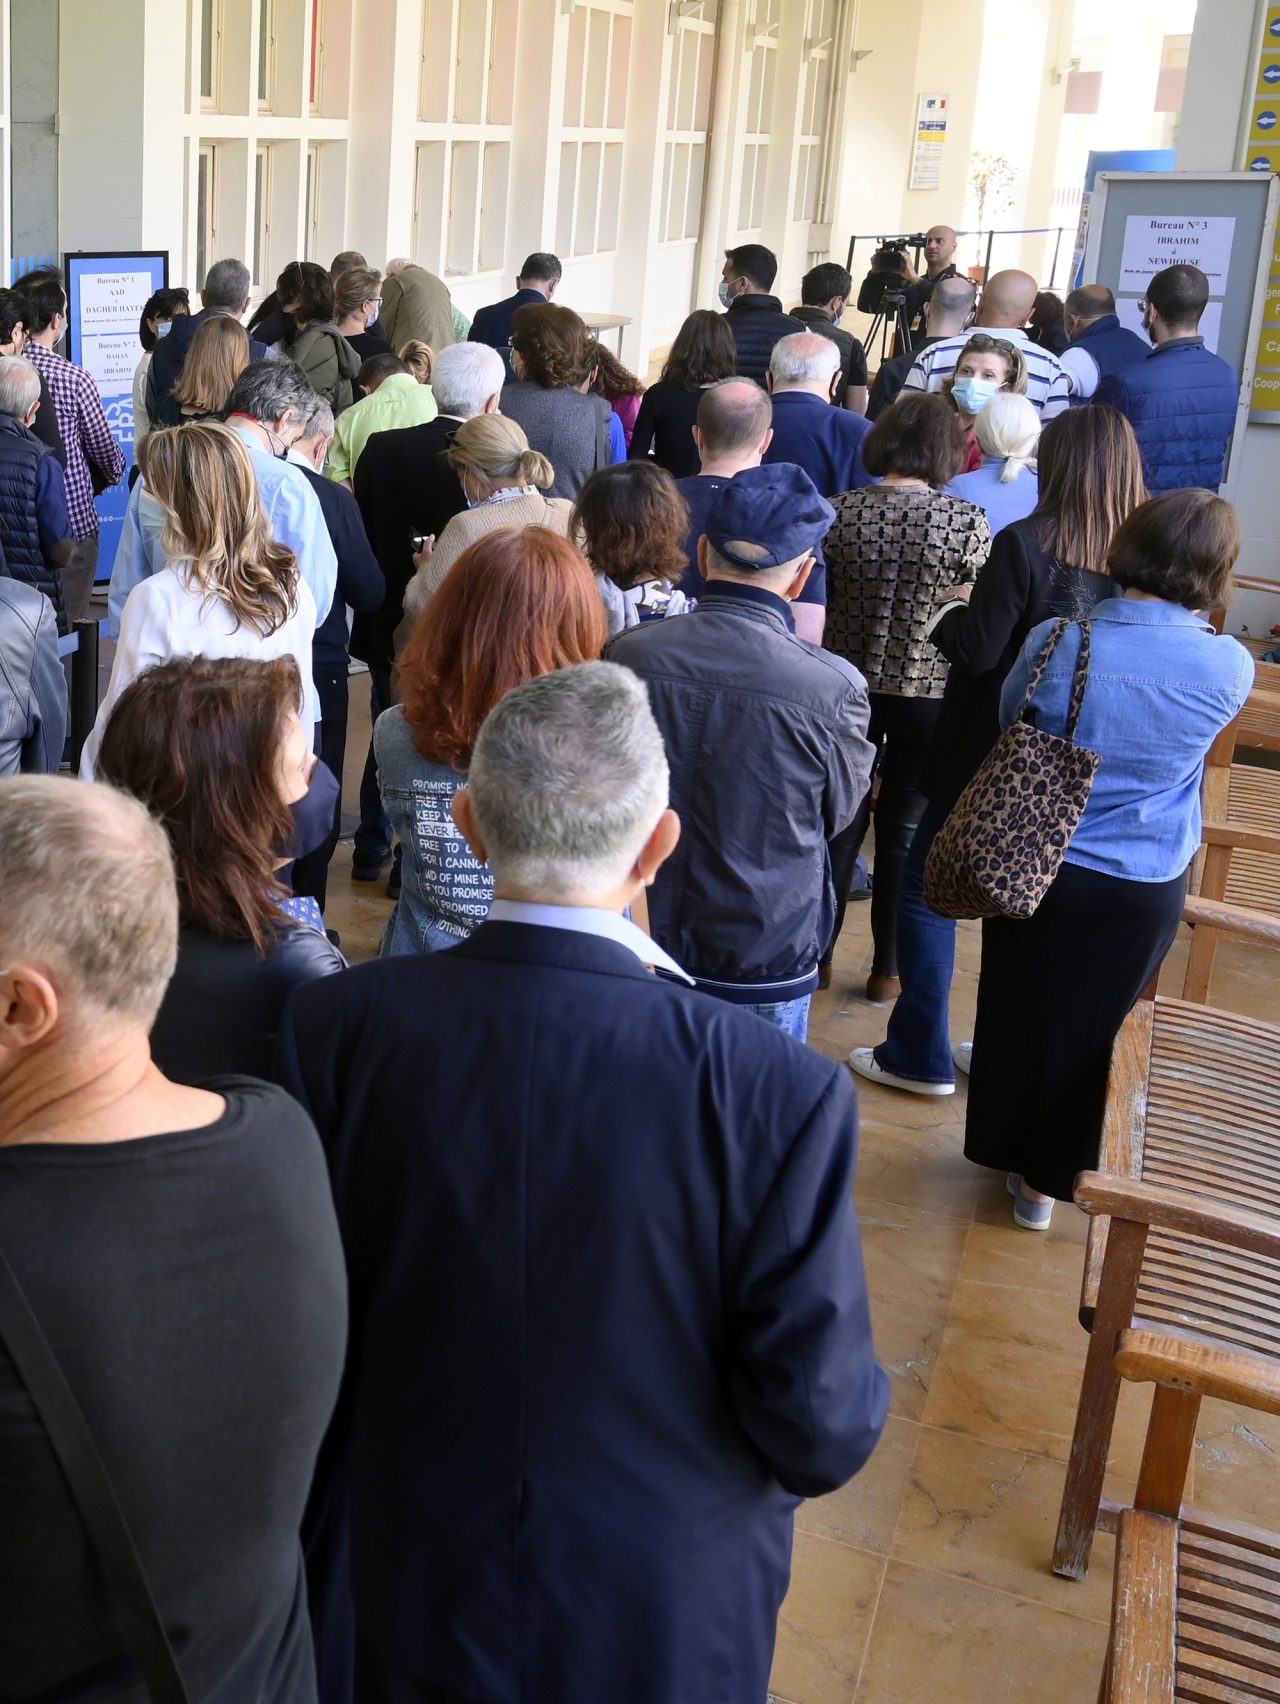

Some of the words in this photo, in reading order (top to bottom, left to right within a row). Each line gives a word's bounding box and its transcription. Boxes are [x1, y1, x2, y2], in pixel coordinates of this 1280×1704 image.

[1150, 220, 1184, 230] Bureau
[1202, 221, 1208, 230] 3
[1157, 237, 1199, 245] IBRAHIM
[1148, 257, 1201, 267] NEWHOUSE
[97, 277, 120, 285] Bureau
[412, 779, 453, 794] PROMISE
[415, 810, 440, 821] KEEP
[416, 824, 450, 837] NEVER
[420, 838, 440, 852] FREE
[444, 842, 459, 854] TO
[422, 852, 438, 866] FOR
[439, 873, 452, 883] OF
[454, 874, 480, 885] MINE
[431, 884, 450, 897] YOU
[440, 900, 489, 916] PROMISED
